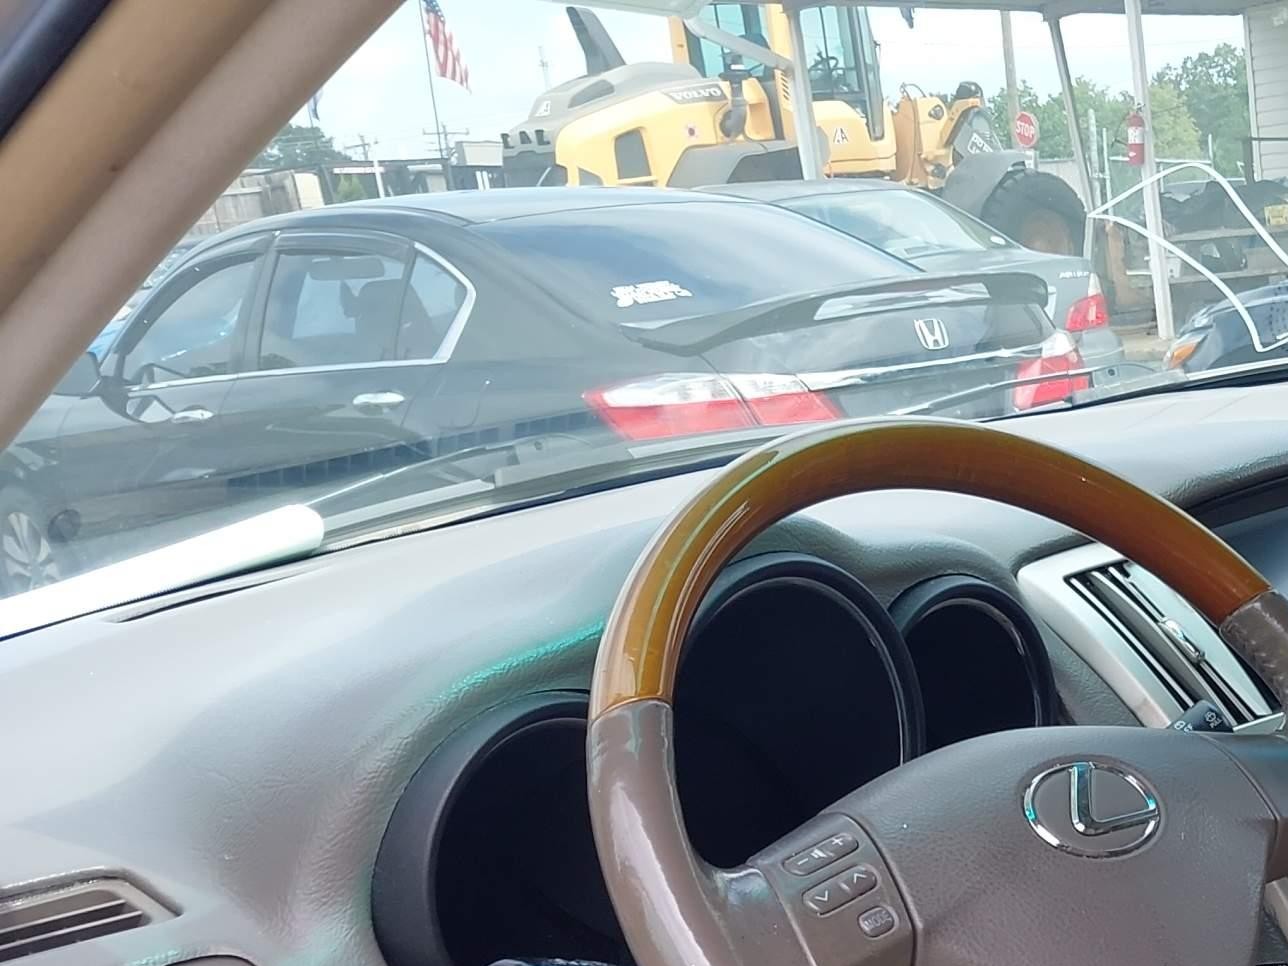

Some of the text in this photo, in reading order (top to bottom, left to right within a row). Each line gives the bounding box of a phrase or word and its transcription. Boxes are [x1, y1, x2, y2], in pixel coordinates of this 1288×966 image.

[671, 87, 721, 100] VOLVO
[1015, 120, 1035, 138] STOP
[863, 909, 893, 931] MODE
